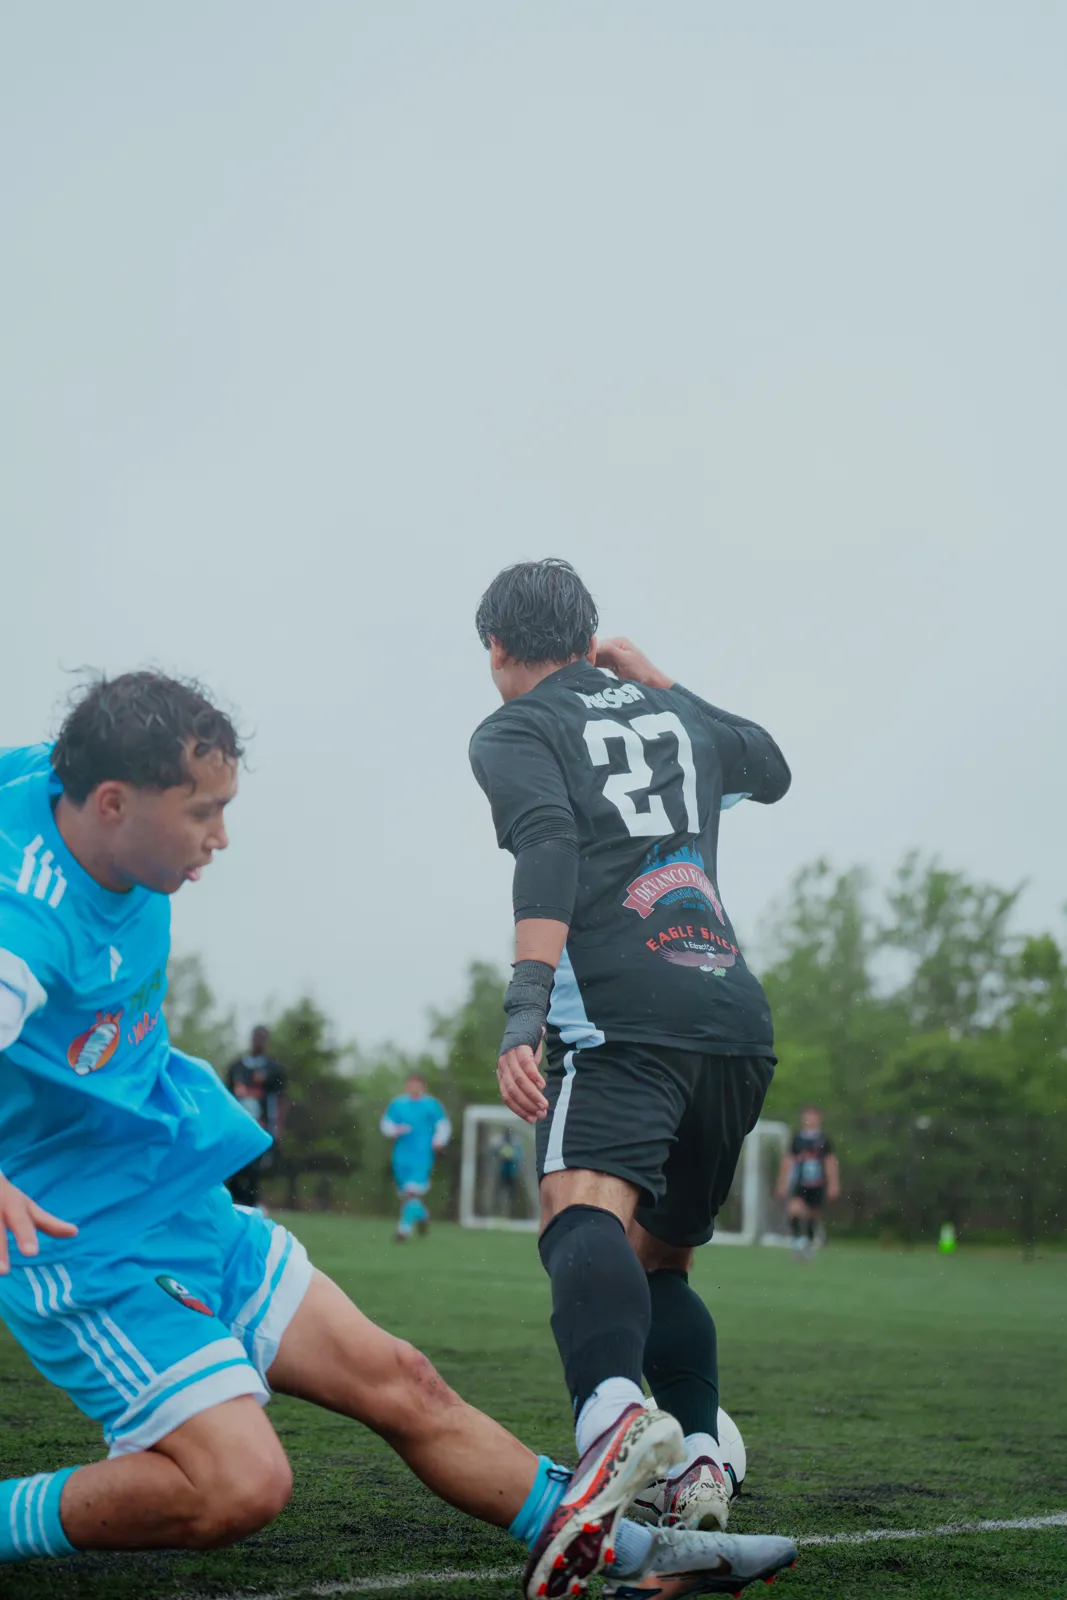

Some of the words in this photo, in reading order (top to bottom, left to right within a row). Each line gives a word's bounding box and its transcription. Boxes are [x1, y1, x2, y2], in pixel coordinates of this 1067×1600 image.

[583, 711, 701, 838] 27
[634, 867, 689, 902] DEVANCO
[645, 925, 693, 951] EAGLE
